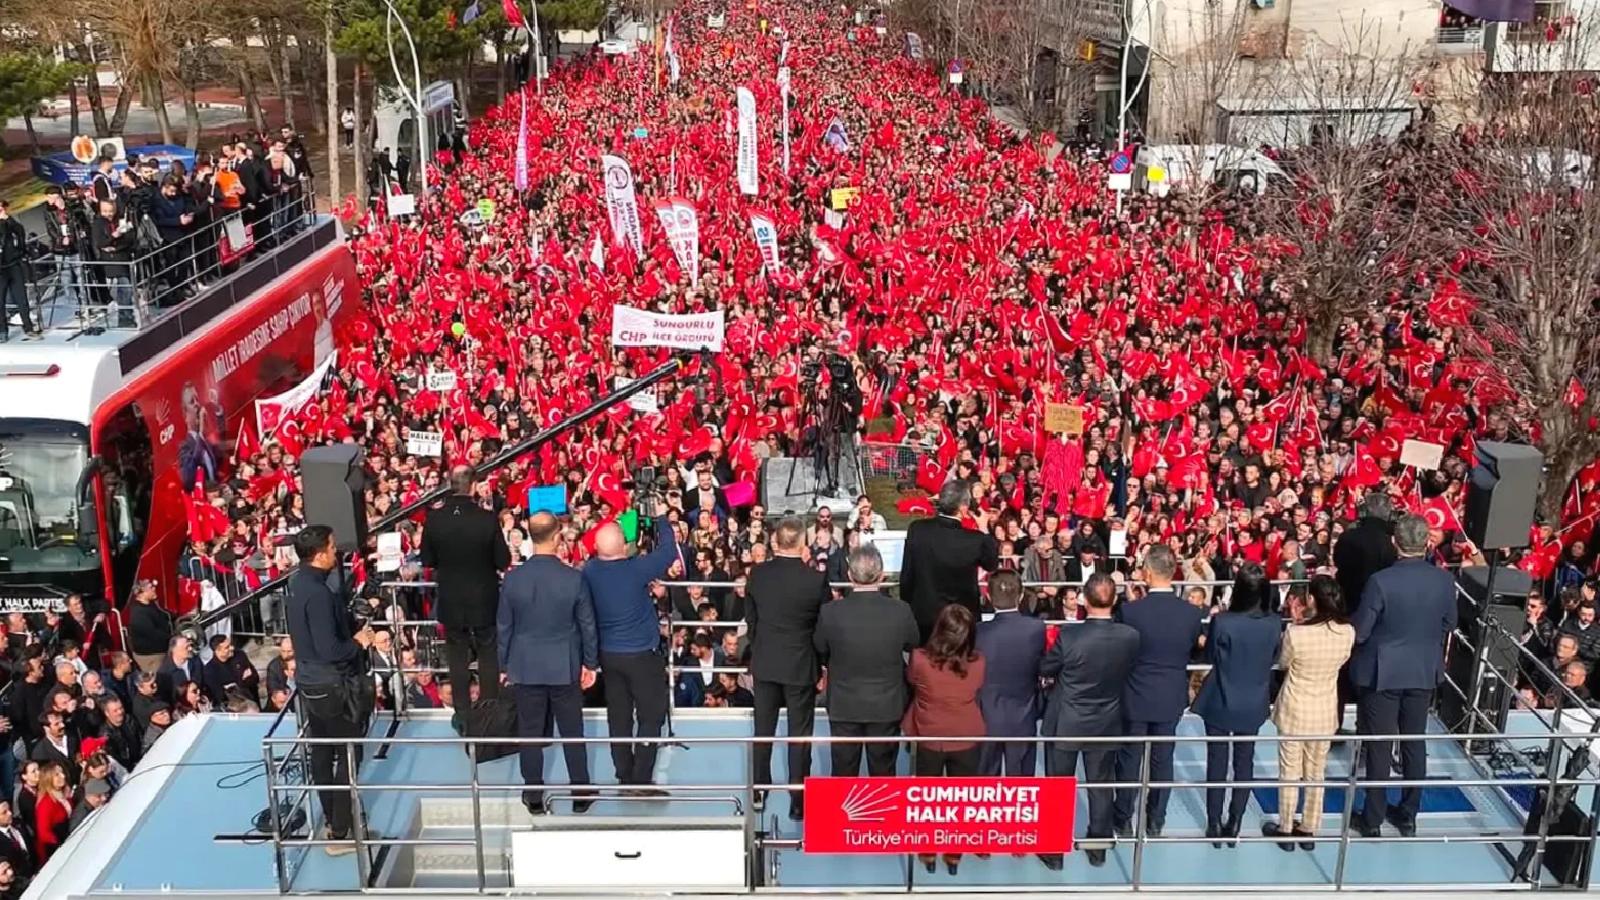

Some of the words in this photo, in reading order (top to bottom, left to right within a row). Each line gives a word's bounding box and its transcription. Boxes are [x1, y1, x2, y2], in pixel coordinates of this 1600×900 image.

[619, 330, 647, 342] CHP
[906, 783, 1040, 802] CUMHURİYET
[906, 806, 958, 823] HALK
[963, 802, 1039, 823] PARTİSİ
[843, 828, 929, 848] Türkiye'nin
[934, 828, 983, 845] Birinci
[988, 828, 1038, 845] Partisi
